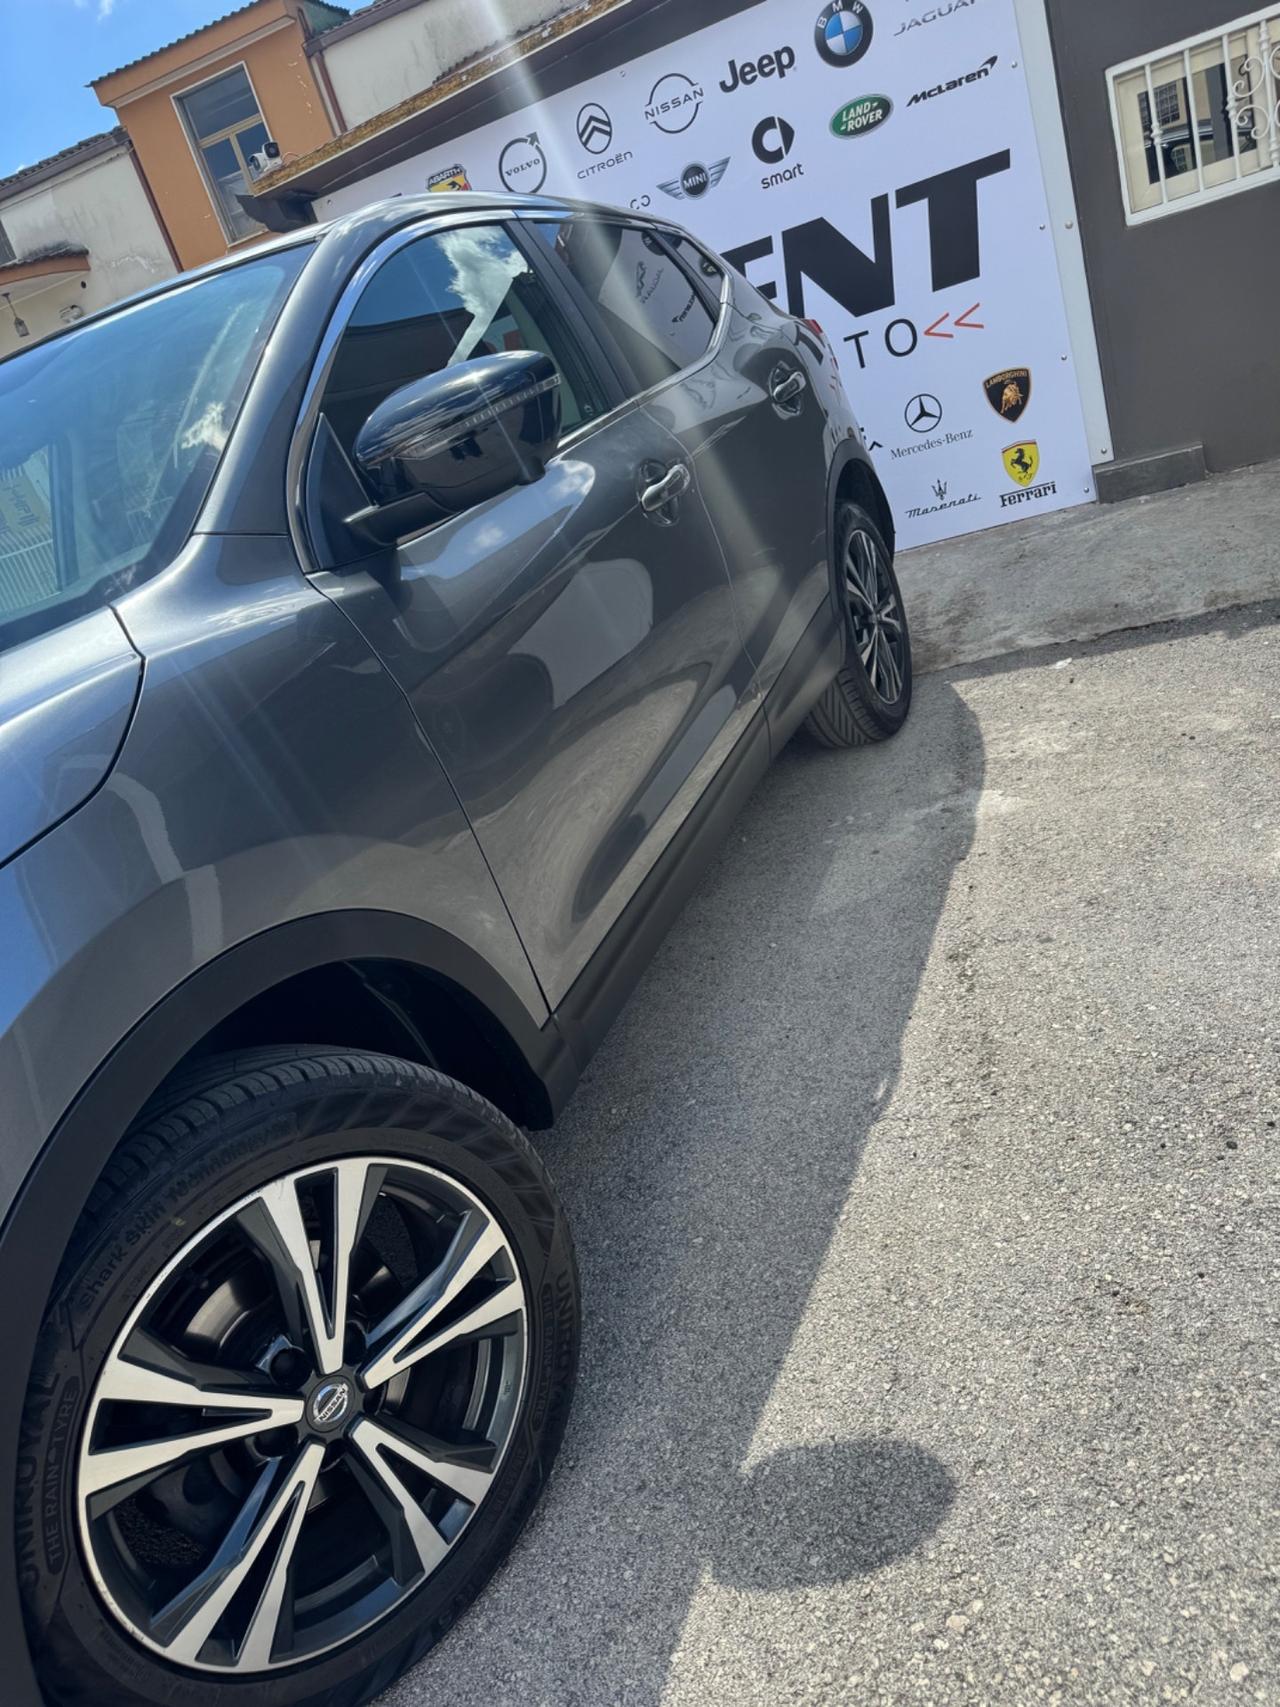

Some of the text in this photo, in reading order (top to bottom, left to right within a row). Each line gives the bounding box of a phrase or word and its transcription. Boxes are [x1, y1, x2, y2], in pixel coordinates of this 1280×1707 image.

[816, 0, 864, 29] BMW
[719, 45, 796, 93] Jeep
[906, 67, 990, 107] McLaren
[644, 87, 704, 120] NISSAN
[842, 102, 871, 122] LAND
[847, 109, 883, 132] ROVER
[430, 167, 463, 184] ABARTH
[505, 158, 540, 176] VOLVO
[761, 163, 804, 189] smart
[683, 172, 707, 190] MINI
[986, 369, 1028, 388] LAMBORGHINI
[891, 428, 974, 461] Mercedes-Benz
[905, 492, 982, 519] Maserati
[1000, 480, 1058, 508] Ferrari
[319, 1387, 346, 1420] NISSAN
[45, 1389, 77, 1563] THE RAIN TYRE
